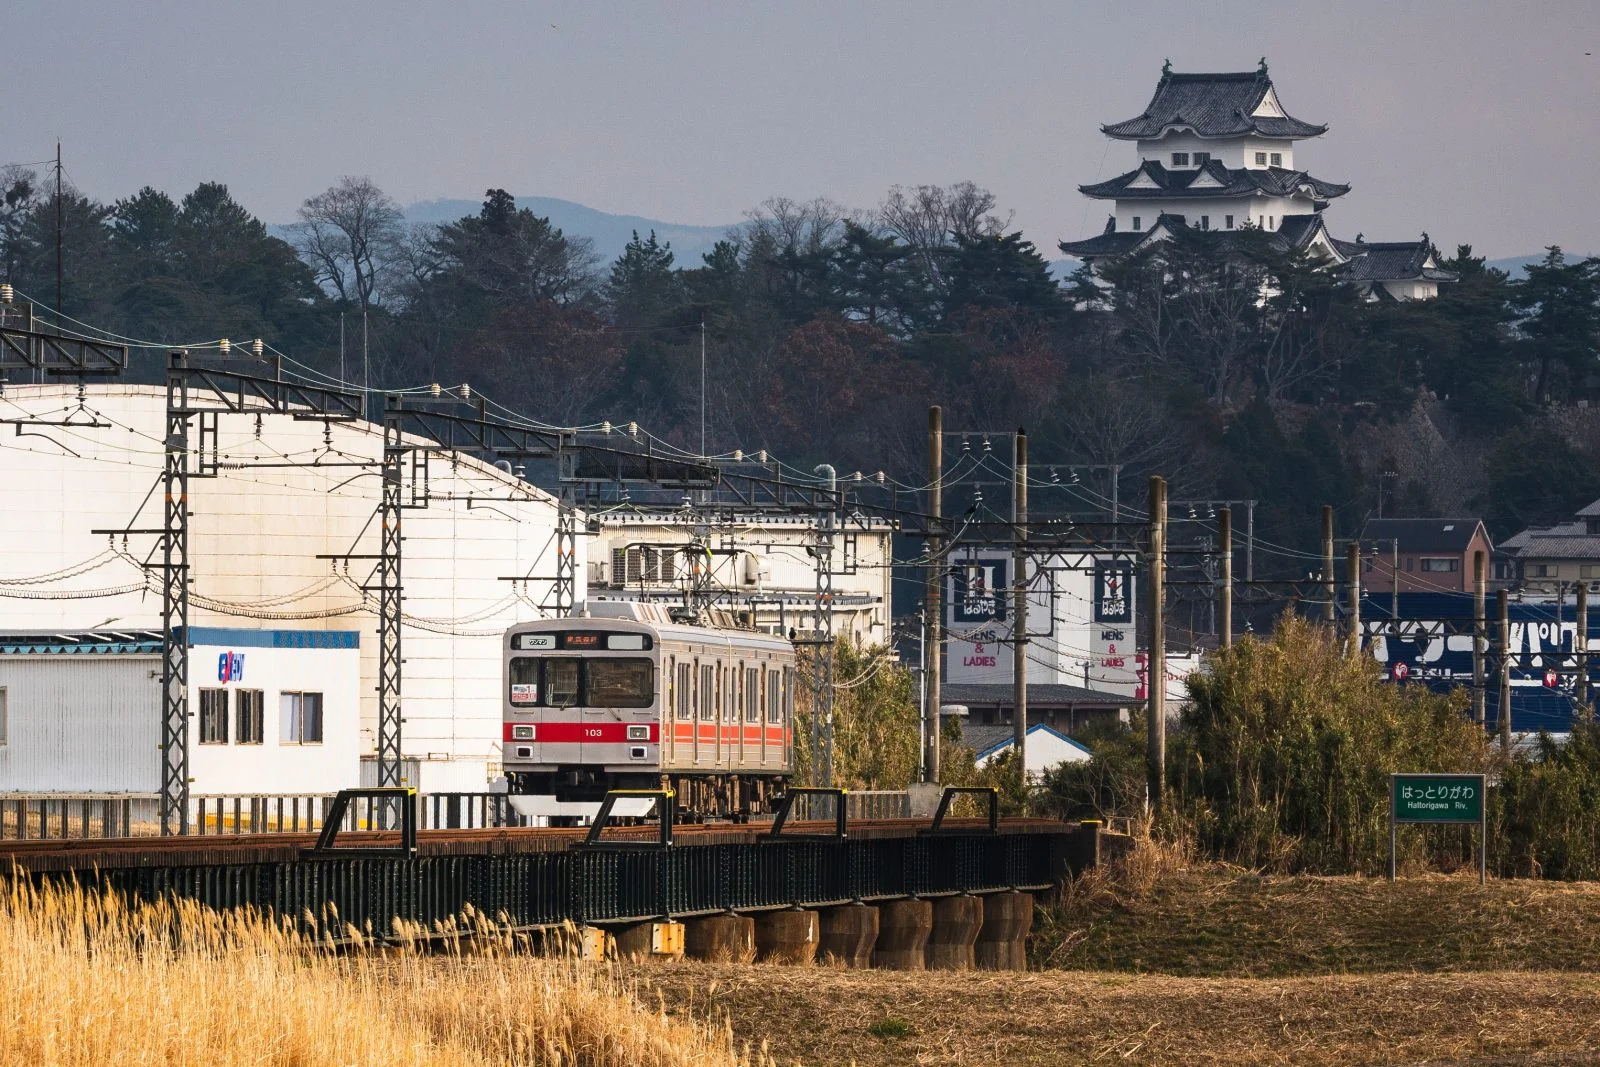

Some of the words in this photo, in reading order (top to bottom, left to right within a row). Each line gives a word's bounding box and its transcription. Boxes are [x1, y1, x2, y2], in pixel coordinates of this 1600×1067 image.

[964, 630, 996, 640] ENS
[1101, 631, 1124, 641] MENS
[974, 643, 985, 653] &
[1108, 644, 1116, 653] &
[963, 656, 996, 667] LADIES
[1101, 657, 1125, 668] LADIES
[585, 729, 602, 737] 103
[1402, 785, 1474, 799] はっとりがわ
[1407, 801, 1449, 810] Hattorigawa
[1454, 801, 1469, 810] Riv.
